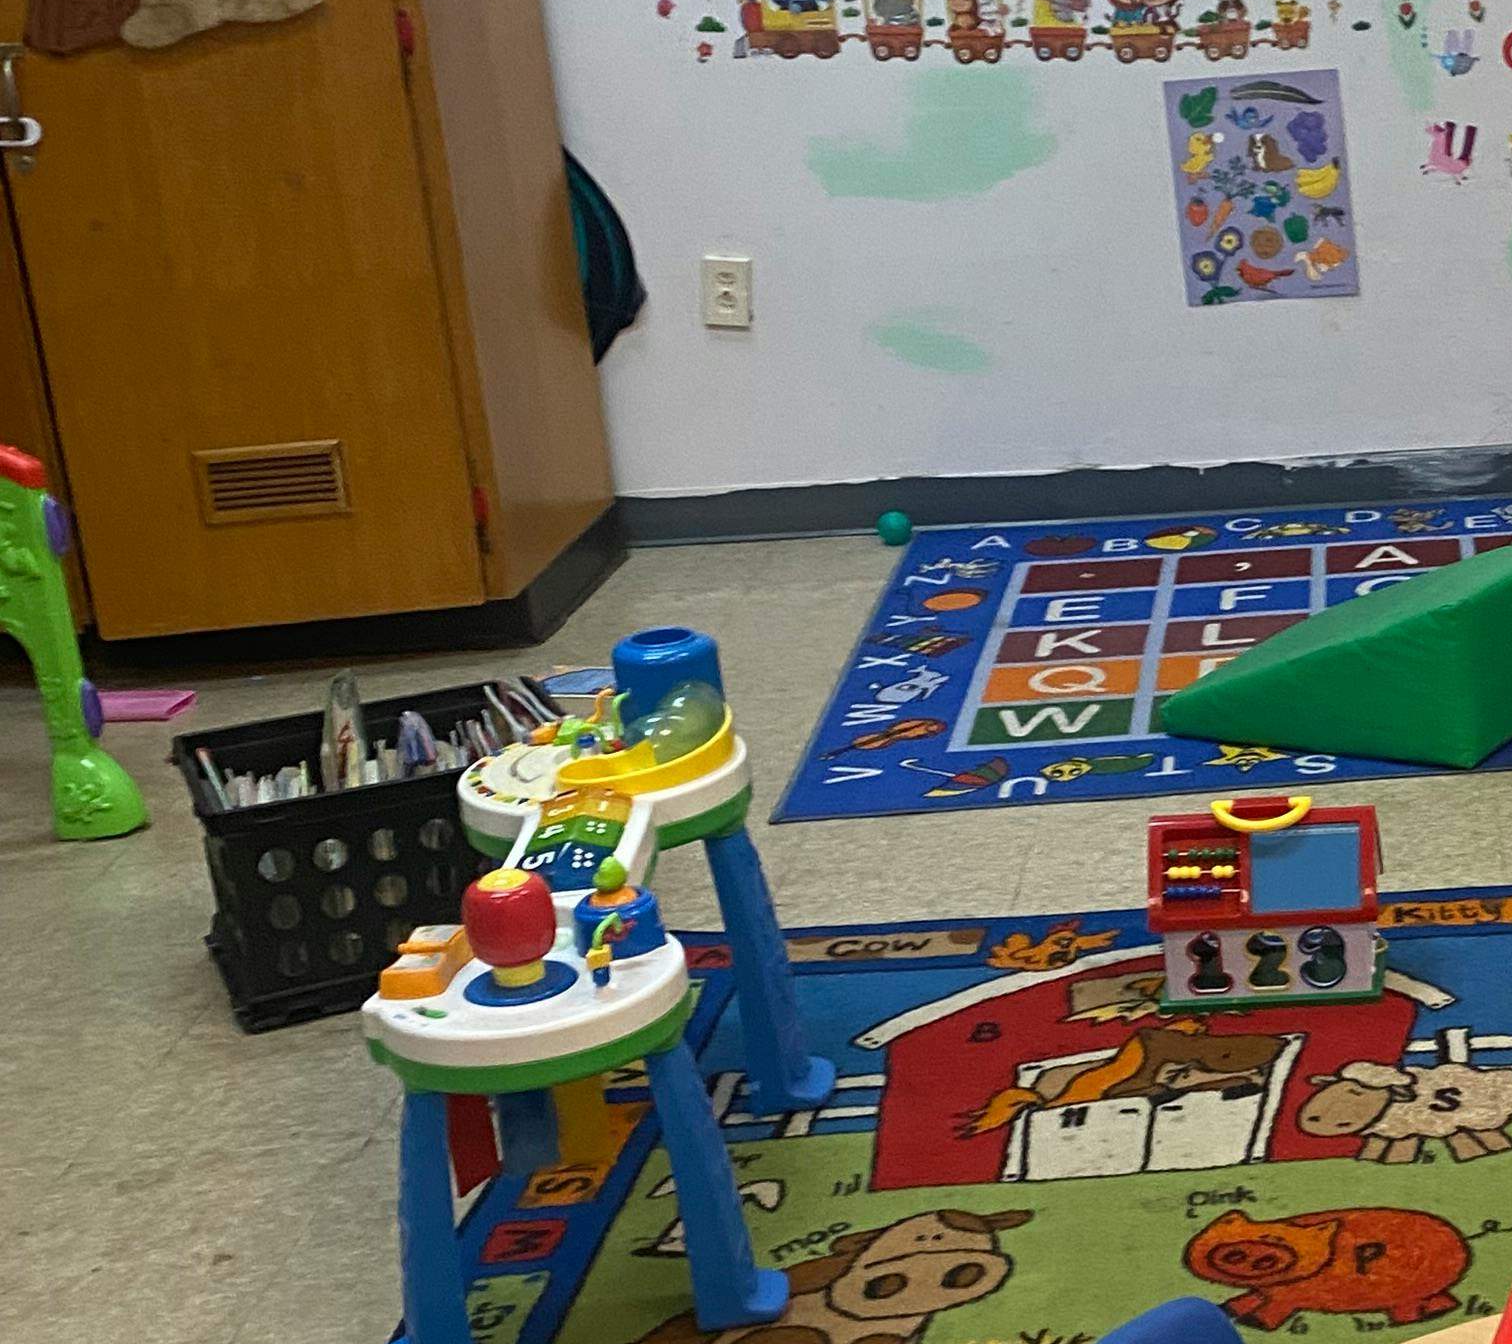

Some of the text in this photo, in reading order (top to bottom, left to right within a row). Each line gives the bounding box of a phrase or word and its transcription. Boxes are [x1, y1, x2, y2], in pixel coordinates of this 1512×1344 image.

[971, 535, 1011, 550] A
[1102, 538, 1140, 553] B
[1224, 517, 1263, 532] C
[1344, 509, 1382, 524] D
[1464, 514, 1500, 529] E
[1354, 544, 1420, 569] A
[1043, 596, 1105, 622] E
[1218, 584, 1274, 611] F
[1034, 628, 1103, 658] K
[1201, 622, 1257, 647] L
[856, 652, 913, 670] X
[1027, 664, 1108, 694] Q
[999, 703, 1102, 738] W
[1143, 756, 1194, 778] T
[1292, 754, 1338, 775] S
[997, 776, 1049, 799] U
[826, 937, 931, 957] Cow
[1246, 929, 1291, 991] 2
[1298, 925, 1347, 989] 3
[1429, 1086, 1463, 1113] S
[769, 1221, 852, 1262] moo
[1354, 1242, 1387, 1275] P
